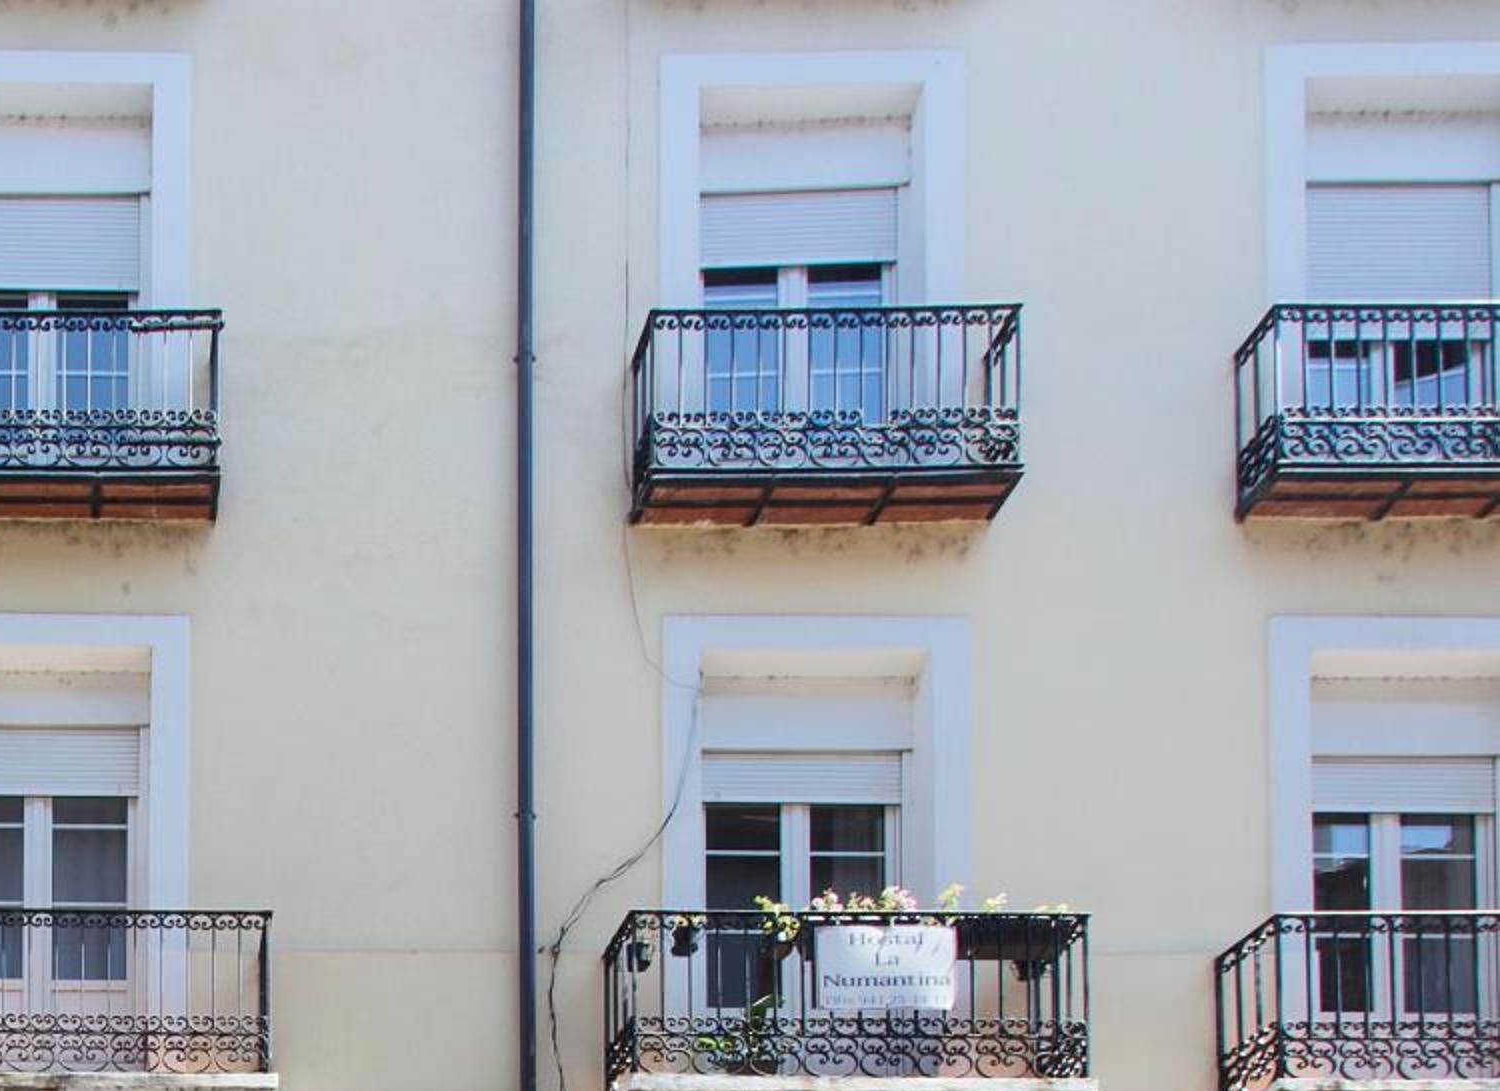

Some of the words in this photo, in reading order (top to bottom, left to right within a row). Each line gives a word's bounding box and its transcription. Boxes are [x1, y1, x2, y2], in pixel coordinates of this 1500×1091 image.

[850, 932, 923, 945] Hostal
[875, 953, 899, 966] La
[823, 974, 949, 987] Numantina
